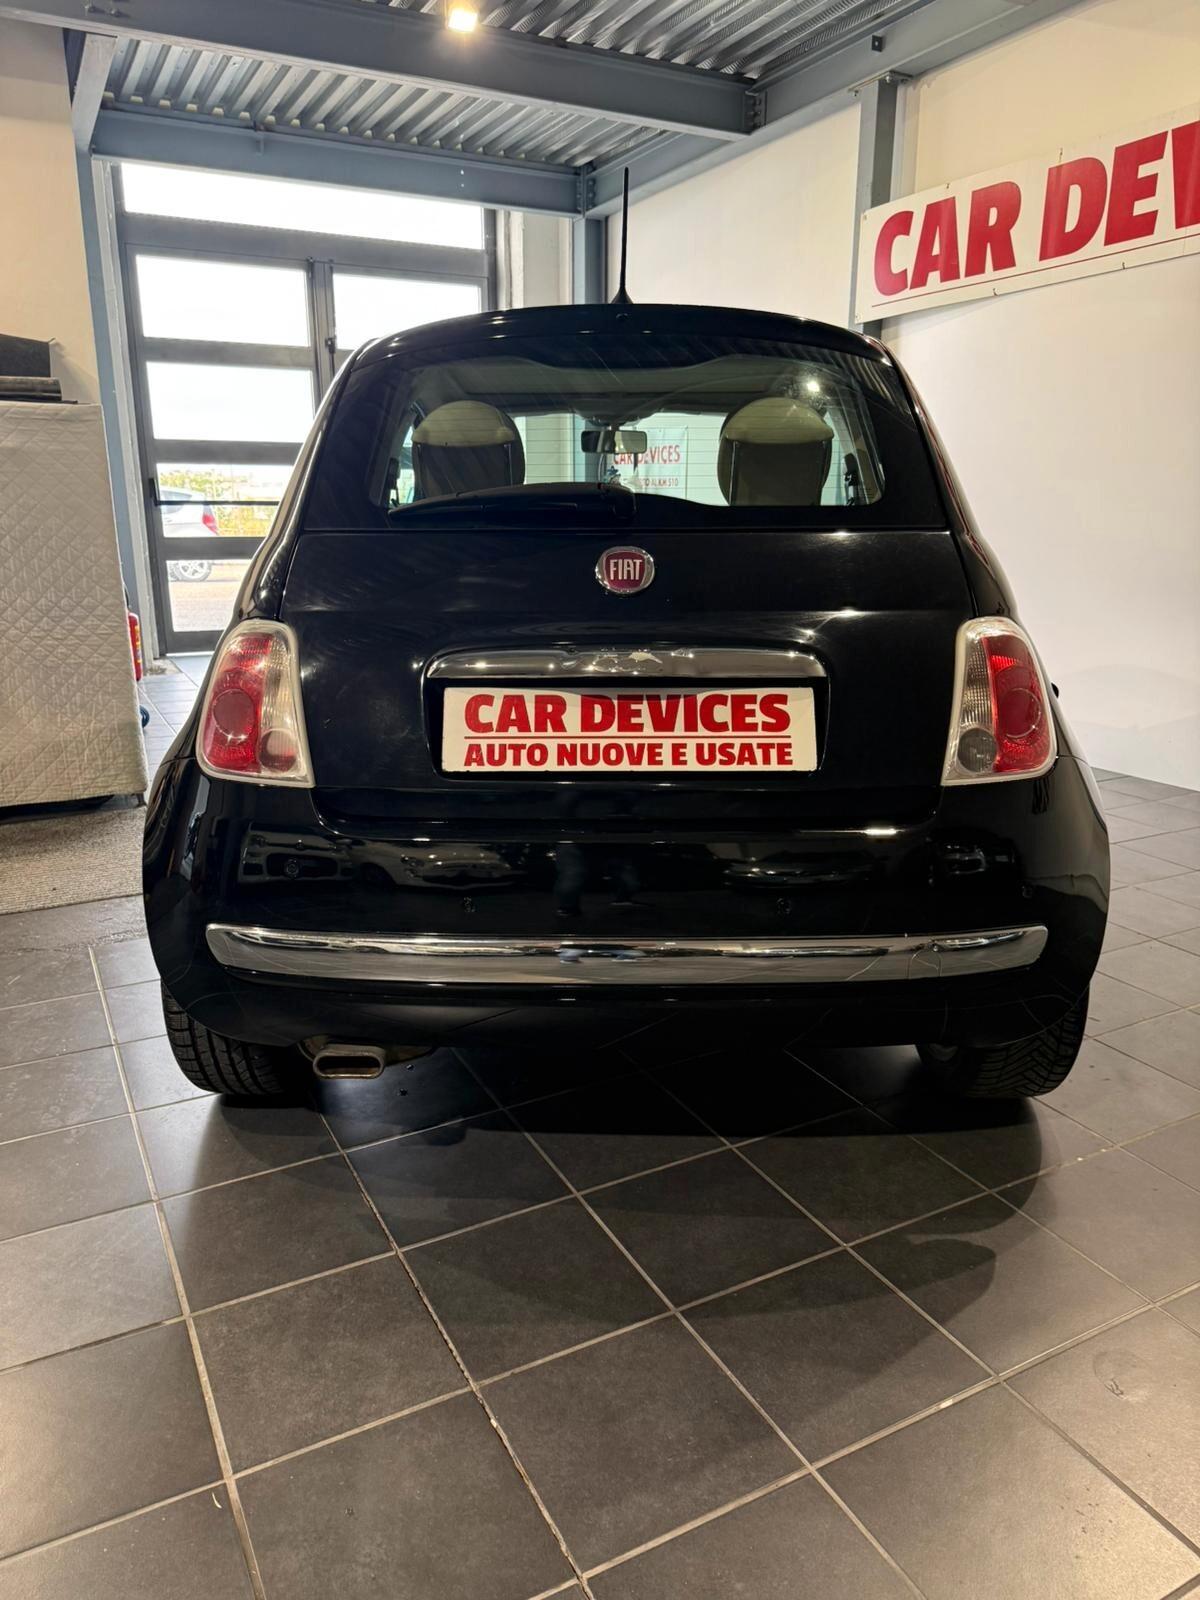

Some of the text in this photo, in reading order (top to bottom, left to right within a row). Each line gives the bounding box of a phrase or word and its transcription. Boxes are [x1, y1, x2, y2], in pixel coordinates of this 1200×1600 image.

[874, 180, 1021, 296] CAR
[610, 559, 643, 580] FIAT
[464, 694, 791, 733] CAR DEVICES
[464, 742, 793, 766] AUTO NUOVE E USATE
